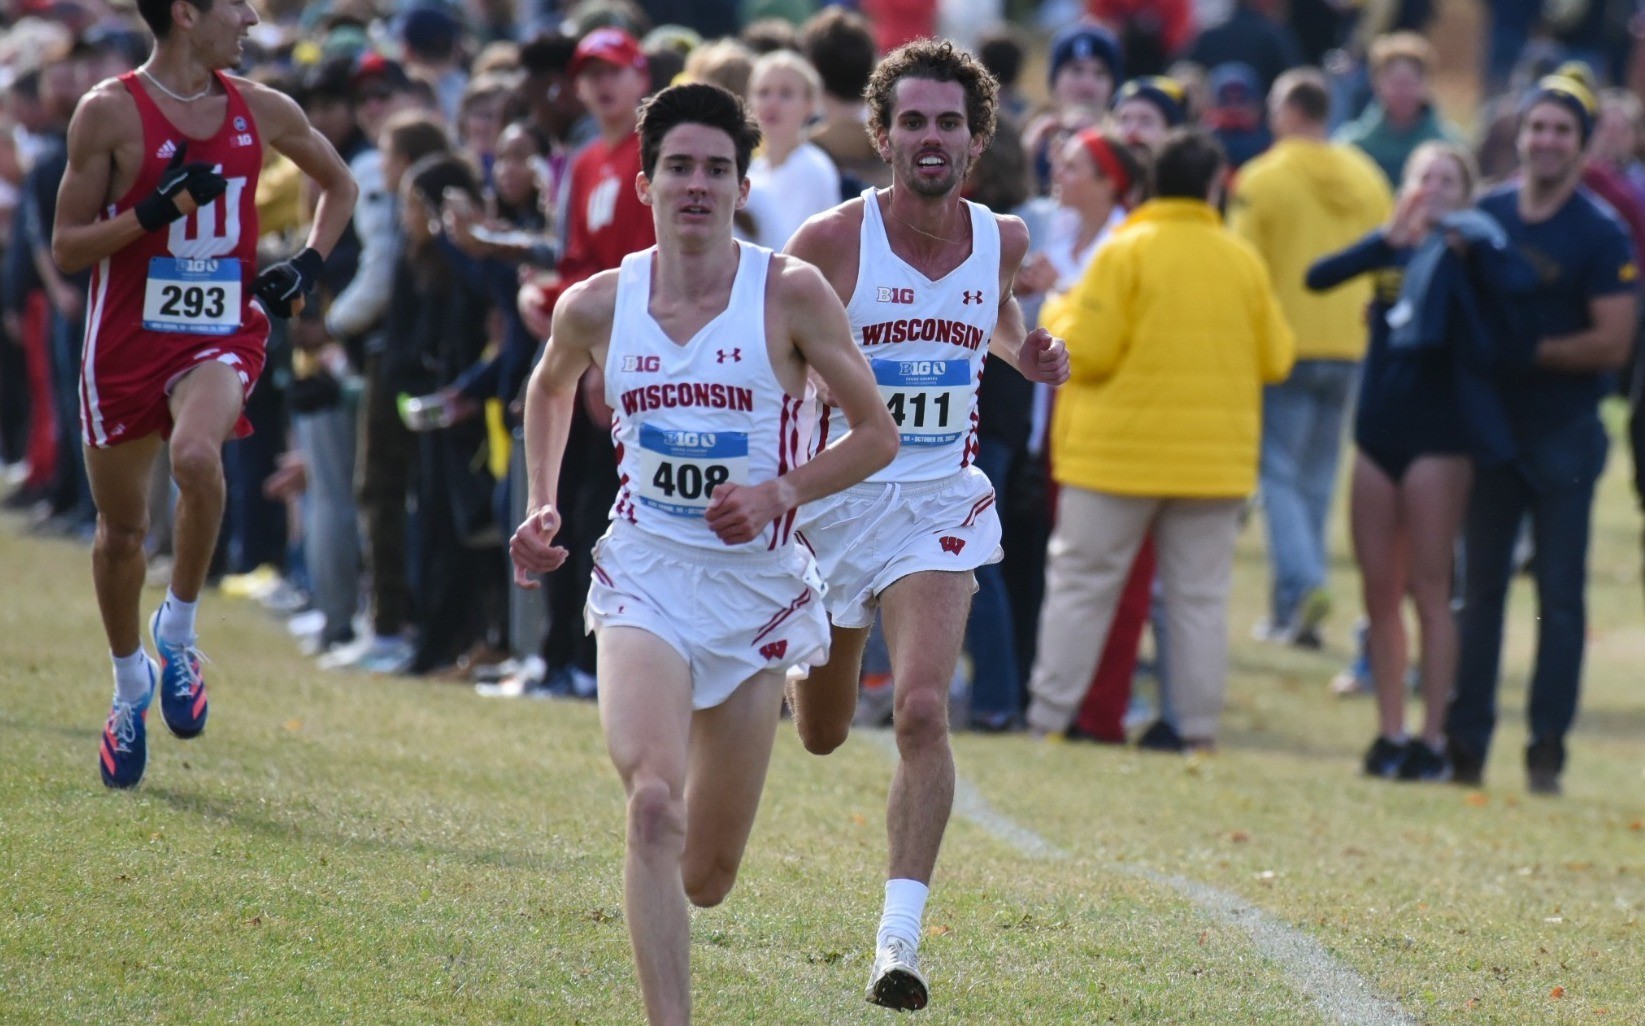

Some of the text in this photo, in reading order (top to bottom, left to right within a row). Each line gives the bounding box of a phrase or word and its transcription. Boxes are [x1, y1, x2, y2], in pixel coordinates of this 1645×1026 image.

[160, 285, 225, 318] 293
[862, 318, 984, 351] WISCONSIN
[621, 382, 753, 417] WISCONSIN
[886, 392, 950, 427] 411
[652, 461, 730, 500] 408
